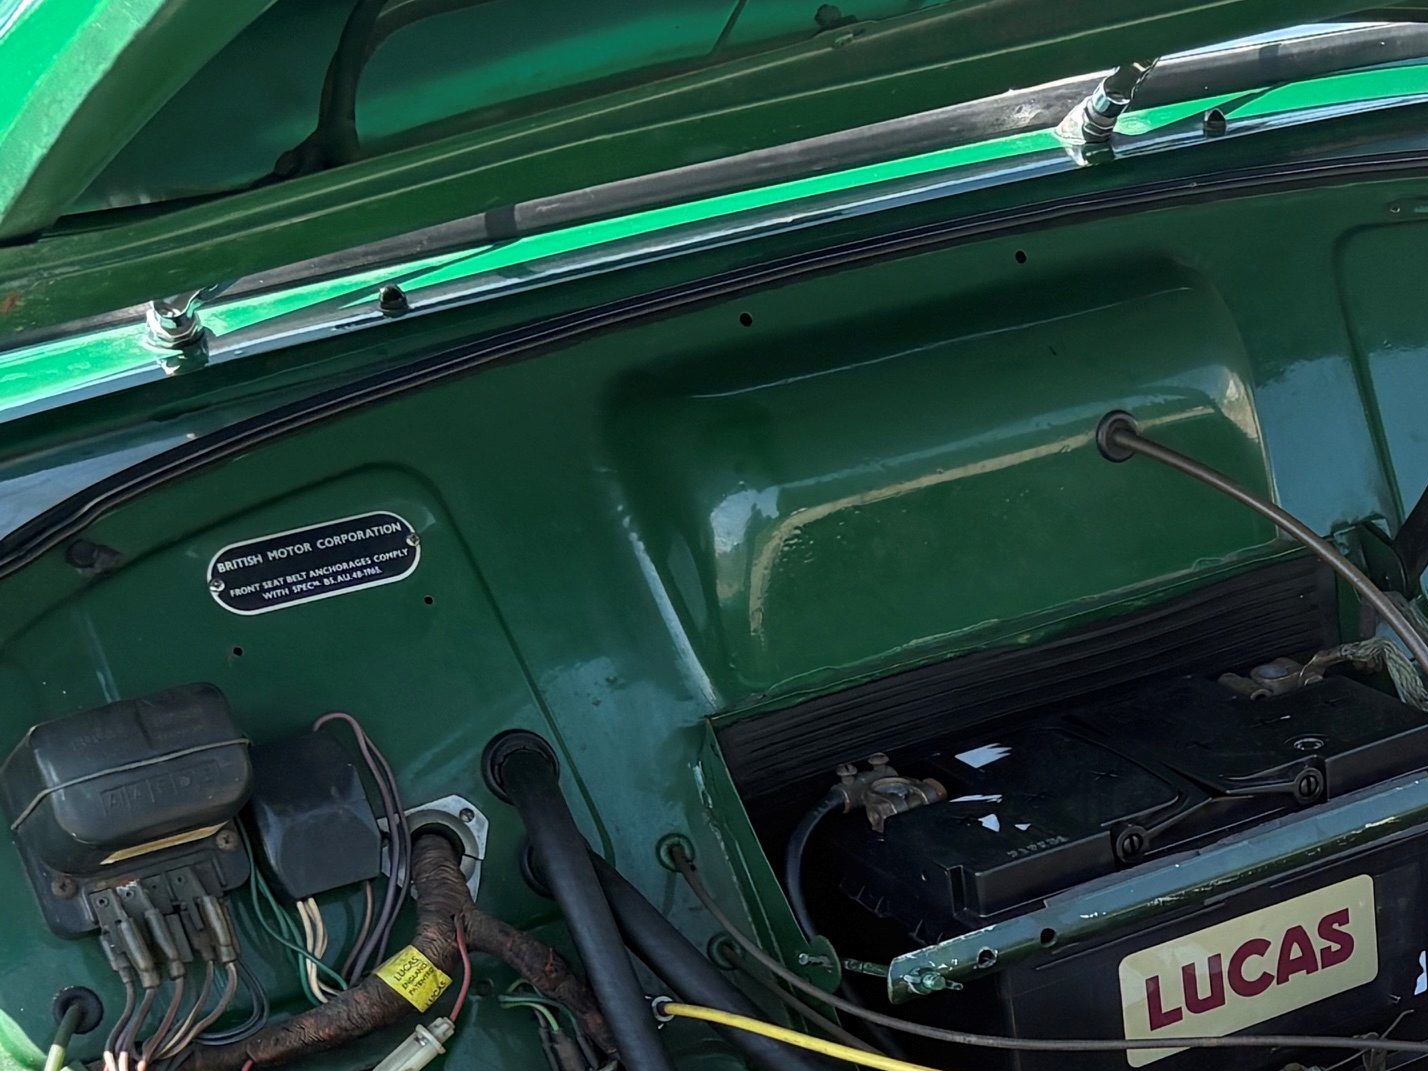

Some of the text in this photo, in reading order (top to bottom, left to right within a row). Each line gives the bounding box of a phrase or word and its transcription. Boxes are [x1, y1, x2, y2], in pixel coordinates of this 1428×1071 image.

[216, 521, 402, 573] BRITISH MOTOR CORPORATION
[229, 548, 408, 598] FRONT SEAT BELT ANCHORAGES COMPLY
[261, 587, 290, 600] WITH
[393, 955, 419, 982] LUCAS
[401, 962, 427, 990] ENGLAND
[408, 966, 434, 996] PATENTED
[1145, 907, 1355, 1031] LUCAS
[424, 980, 447, 1007] LUCAS
